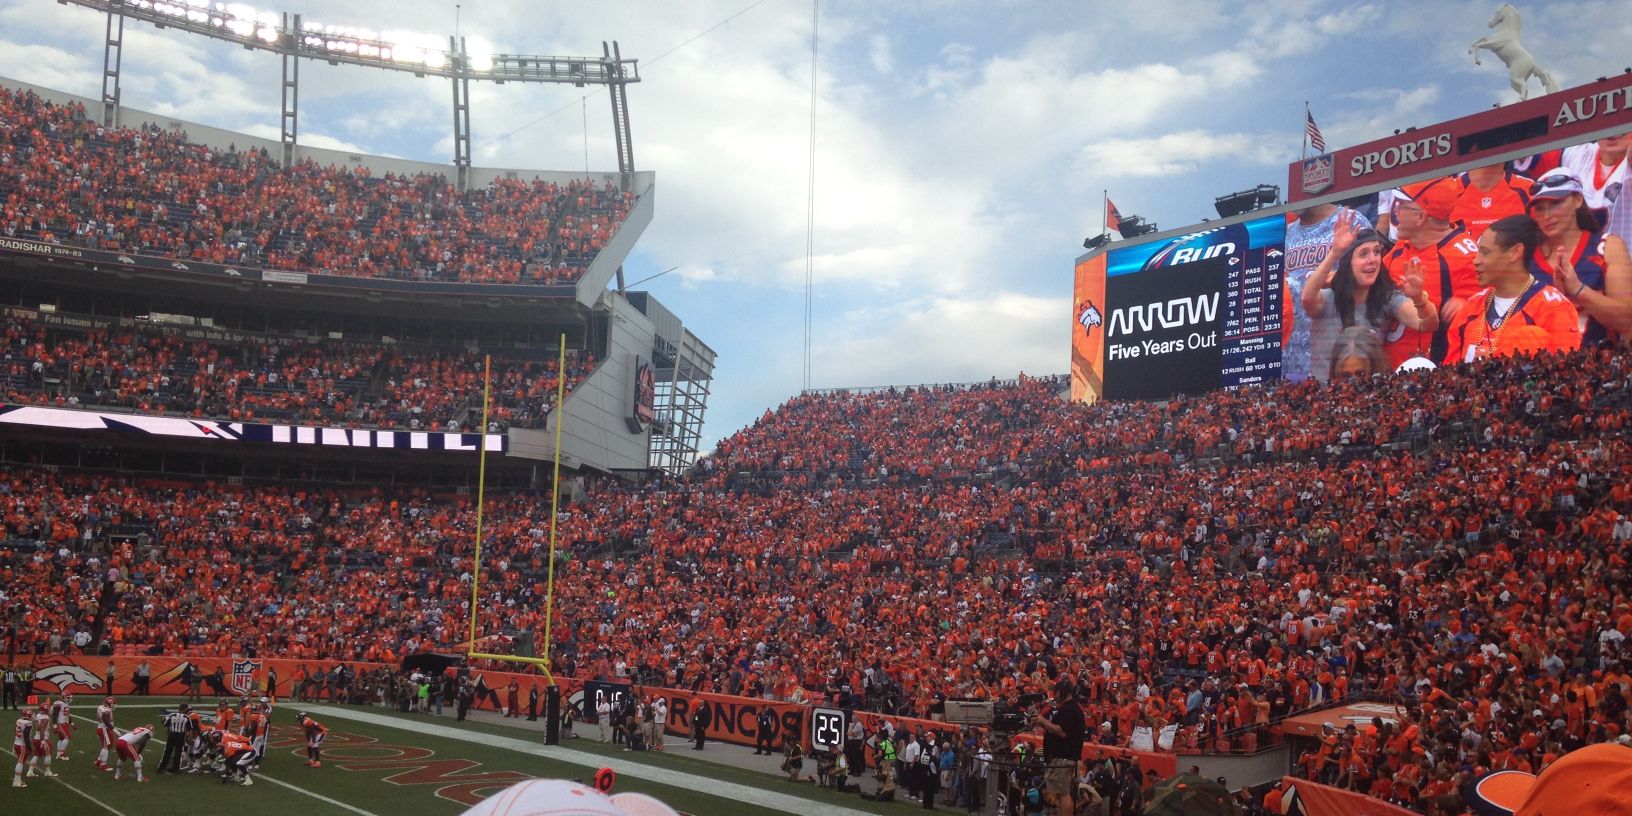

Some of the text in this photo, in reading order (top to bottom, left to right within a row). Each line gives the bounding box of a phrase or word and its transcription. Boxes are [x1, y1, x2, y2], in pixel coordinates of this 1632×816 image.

[1350, 132, 1451, 177] SPORTS
[0, 239, 52, 254] RADISHAR
[1453, 237, 1479, 255] 18
[1228, 263, 1280, 279] 247 PASS 237
[1244, 276, 1262, 285] RUSH
[1243, 297, 1261, 305] FIRST
[1264, 323, 1281, 331] 23:31
[1109, 331, 1217, 361] Five Years Out
[1239, 337, 1264, 345] Manning
[1239, 376, 1262, 384] Sanders
[236, 674, 251, 690] NF
[817, 715, 840, 745] 25
